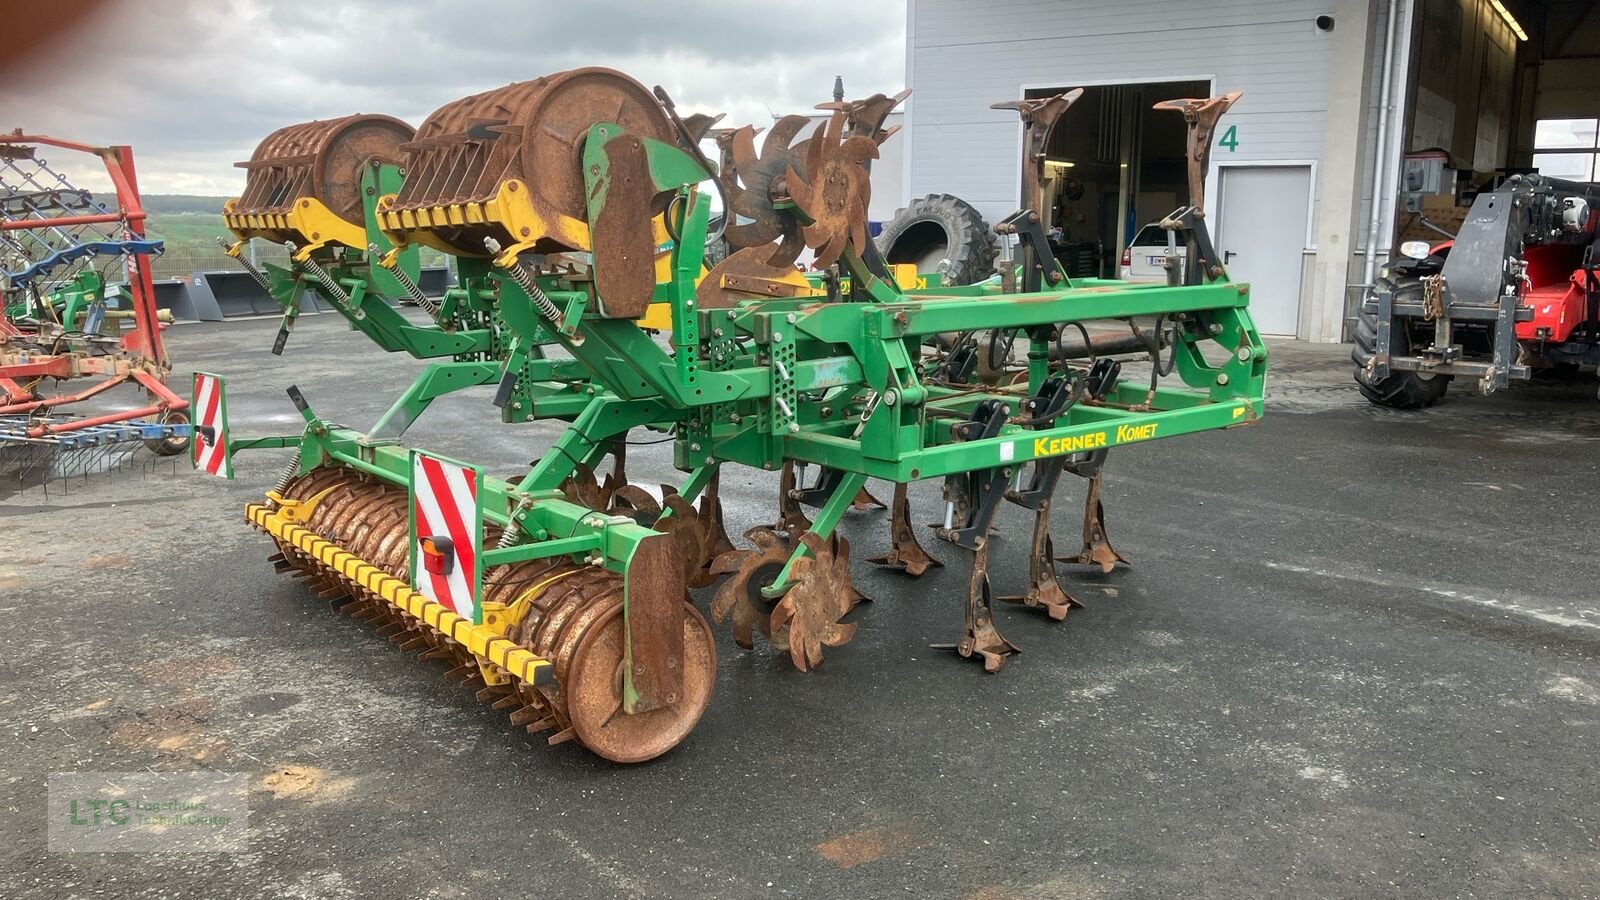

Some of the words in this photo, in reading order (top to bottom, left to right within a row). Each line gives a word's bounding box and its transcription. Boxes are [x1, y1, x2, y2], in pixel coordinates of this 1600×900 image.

[1218, 125, 1239, 152] 4
[1033, 431, 1107, 457] KERNER
[1116, 423, 1159, 443] KOMET
